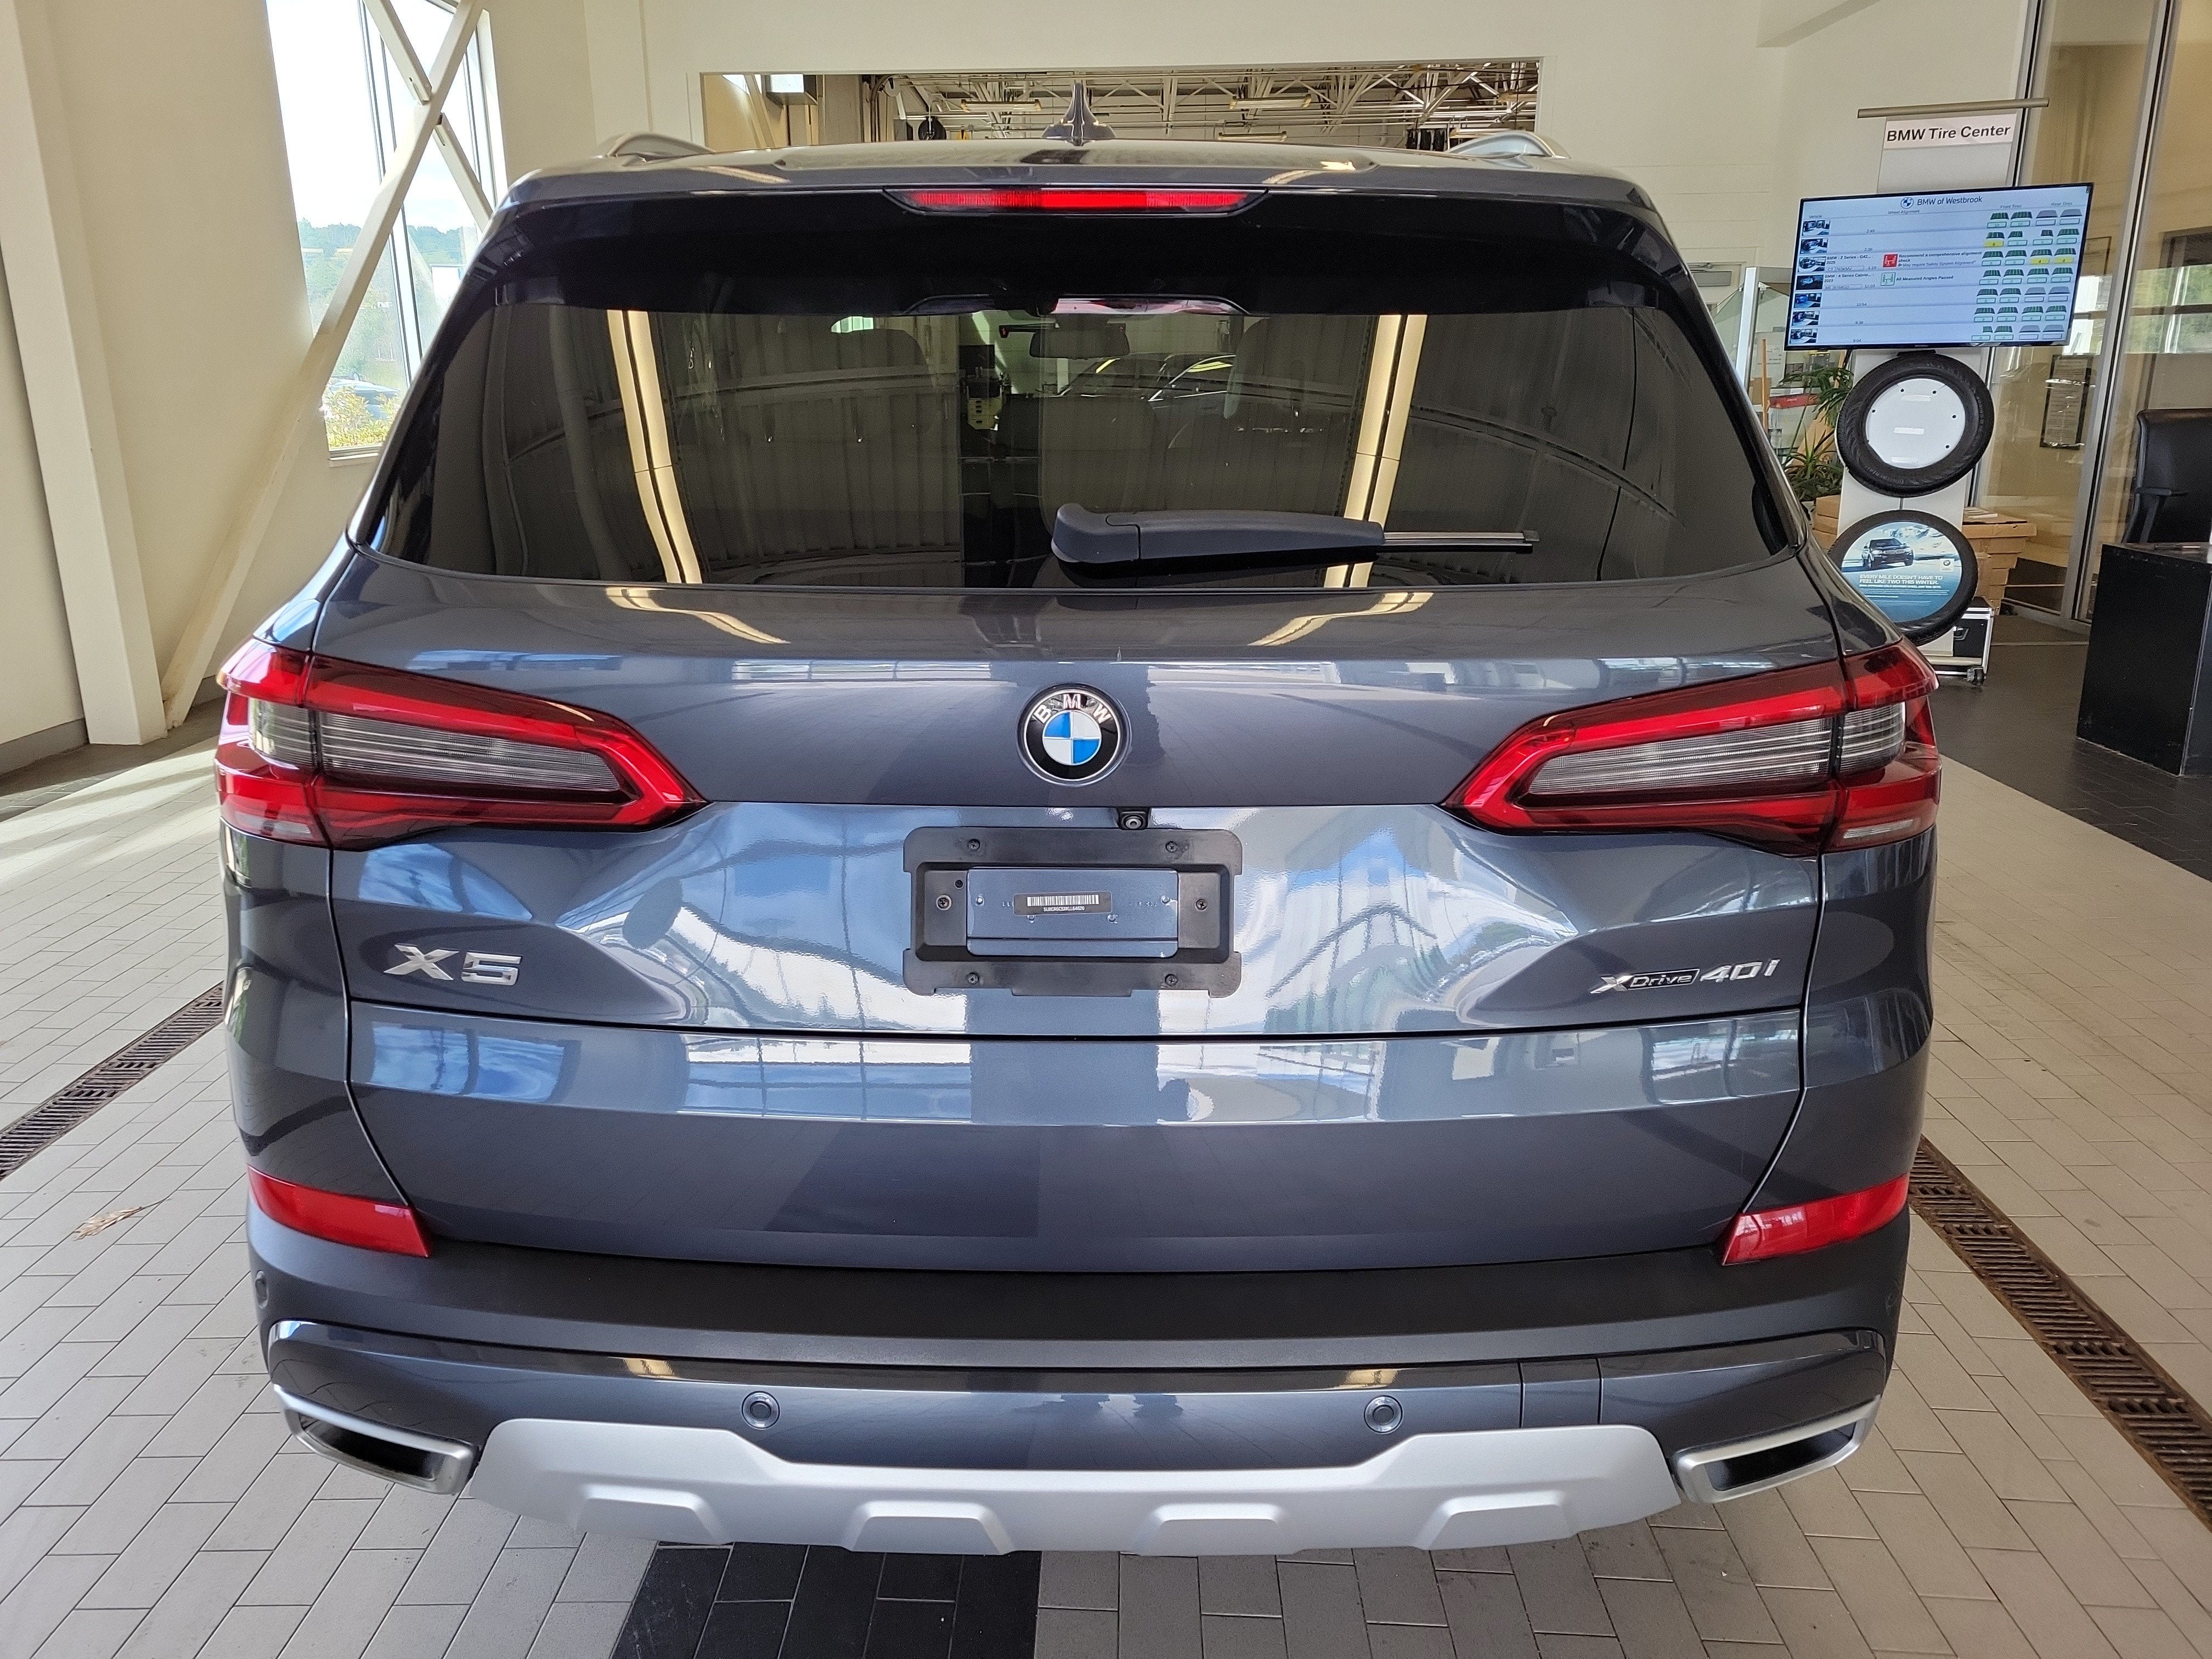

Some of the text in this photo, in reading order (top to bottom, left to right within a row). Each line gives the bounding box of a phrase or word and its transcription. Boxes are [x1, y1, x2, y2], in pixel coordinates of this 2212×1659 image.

[1886, 126, 2011, 142] BMW Tire Center
[1946, 196, 1983, 204] Westbrook
[1032, 693, 1111, 724] BMW
[383, 943, 522, 986] X5
